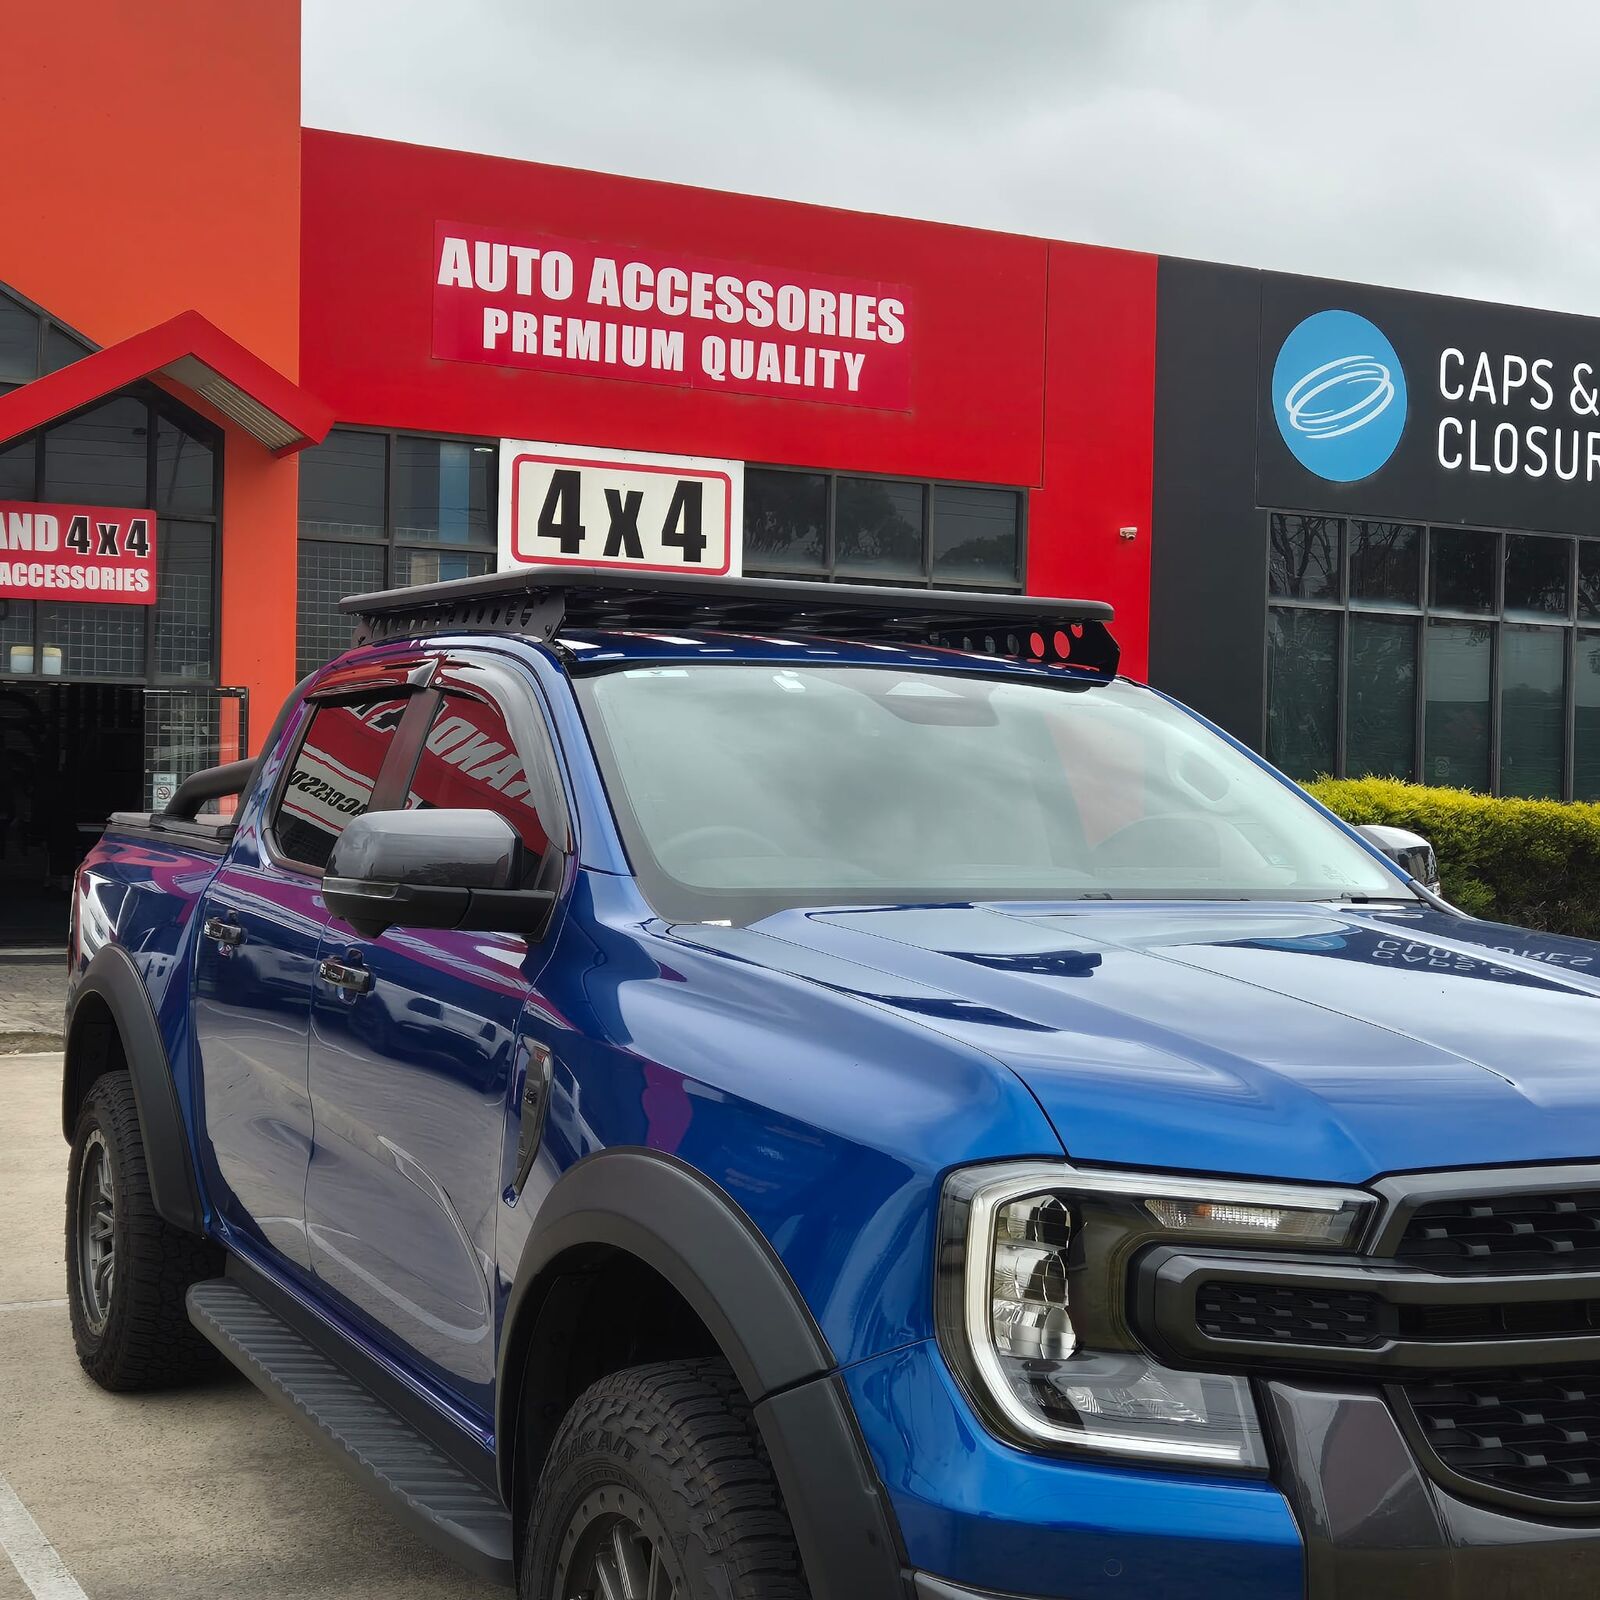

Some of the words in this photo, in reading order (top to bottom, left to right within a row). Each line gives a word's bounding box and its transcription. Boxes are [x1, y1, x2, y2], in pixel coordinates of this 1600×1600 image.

[437, 236, 574, 301] AUTO
[587, 257, 906, 344] ACCESSORIES
[482, 307, 685, 372] PREMIUM
[701, 335, 866, 392] QUALITY
[1439, 347, 1554, 411] CAPS
[1569, 362, 1600, 417] &
